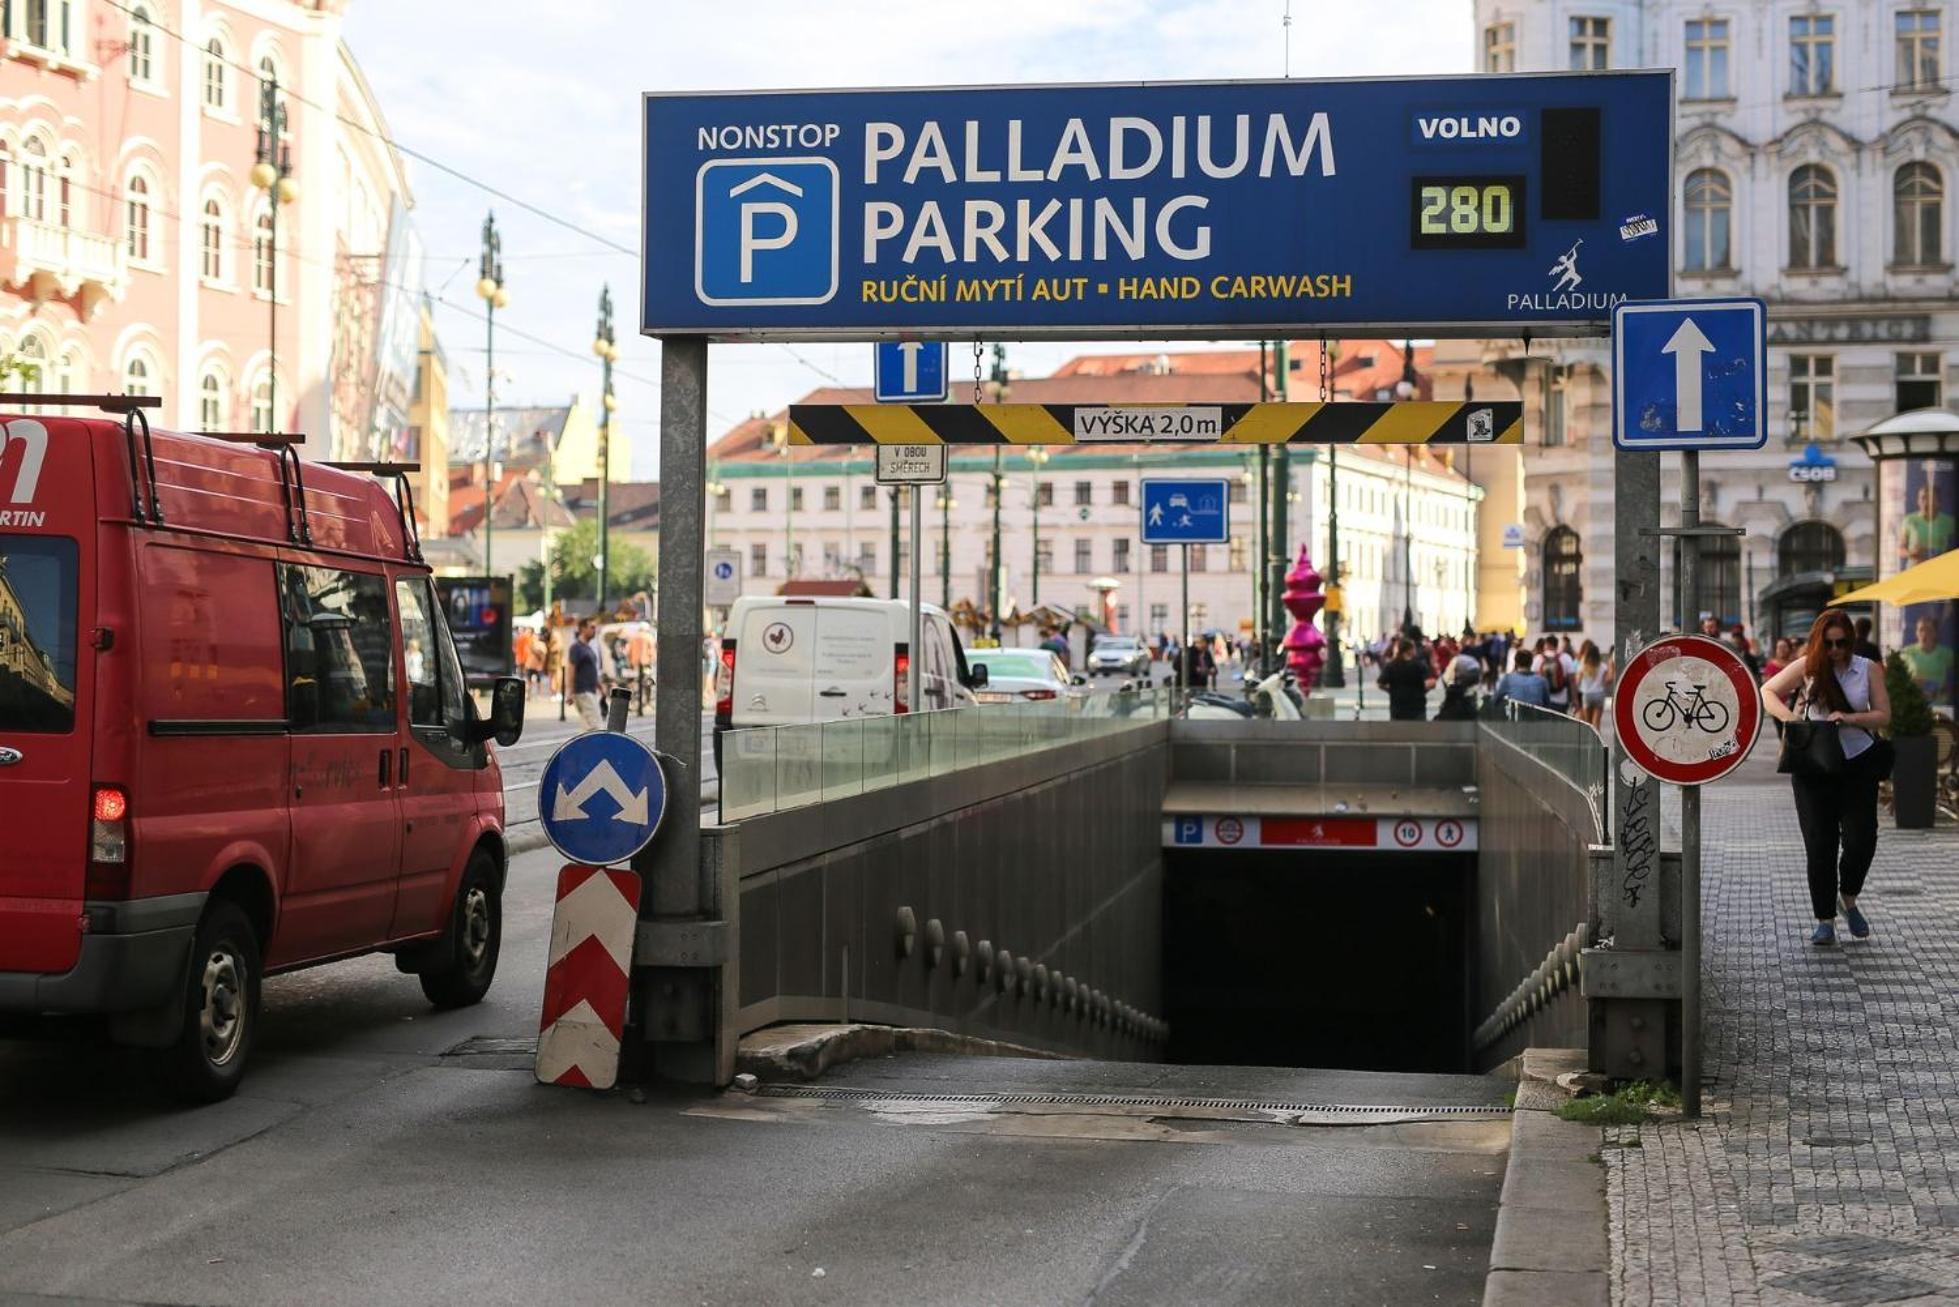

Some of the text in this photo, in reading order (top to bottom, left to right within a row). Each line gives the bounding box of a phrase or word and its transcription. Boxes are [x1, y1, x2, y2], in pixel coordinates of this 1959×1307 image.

[697, 123, 841, 151] NONSTOP
[1418, 116, 1521, 139] VOLNO
[863, 112, 1336, 185] PALLADIUM
[1421, 185, 1511, 234] 280
[740, 202, 799, 283] P
[863, 194, 1211, 264] PARKING
[862, 273, 1352, 303] RUČNÍ MYTÍ AUT HAND CARWASH
[1507, 293, 1627, 310] PALLADIUM
[1080, 410, 1155, 436] VÝŠKA
[1183, 823, 1197, 842] P
[1402, 827, 1416, 839] 10
